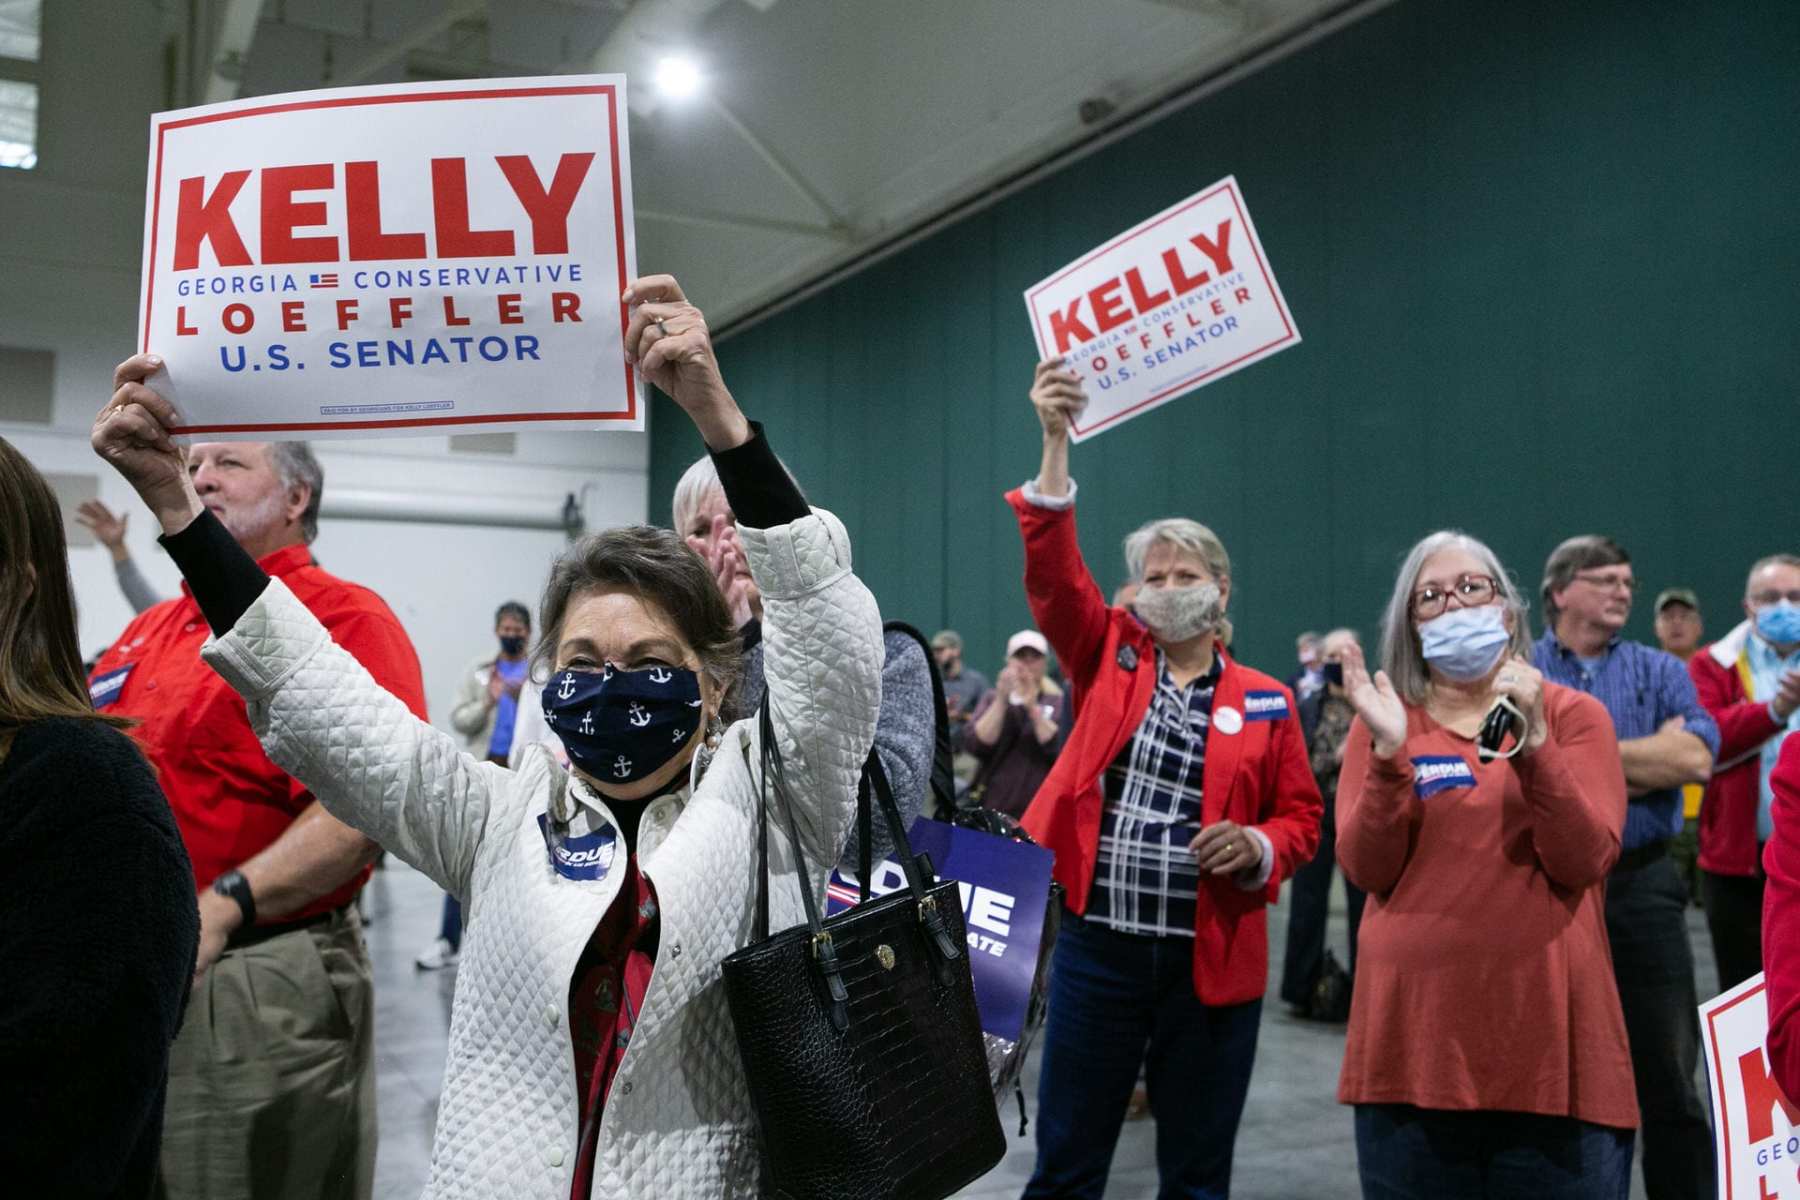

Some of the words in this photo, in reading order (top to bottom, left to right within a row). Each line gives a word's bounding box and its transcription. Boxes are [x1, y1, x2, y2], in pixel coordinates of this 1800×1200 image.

[172, 152, 596, 272] KELLY
[177, 273, 298, 297] GEORGIA
[354, 264, 583, 290] CONSERVATIVE
[1048, 218, 1234, 354] KELLY
[1143, 271, 1245, 328] CONSERVATIVE
[176, 292, 584, 337] LOEFFLER
[220, 343, 306, 373] U.S.
[329, 335, 541, 369] SENATOR
[1097, 367, 1137, 391] U.S.
[1143, 315, 1240, 369] SENATOR
[967, 932, 1008, 957] ATE
[1756, 1136, 1800, 1166] GEO
